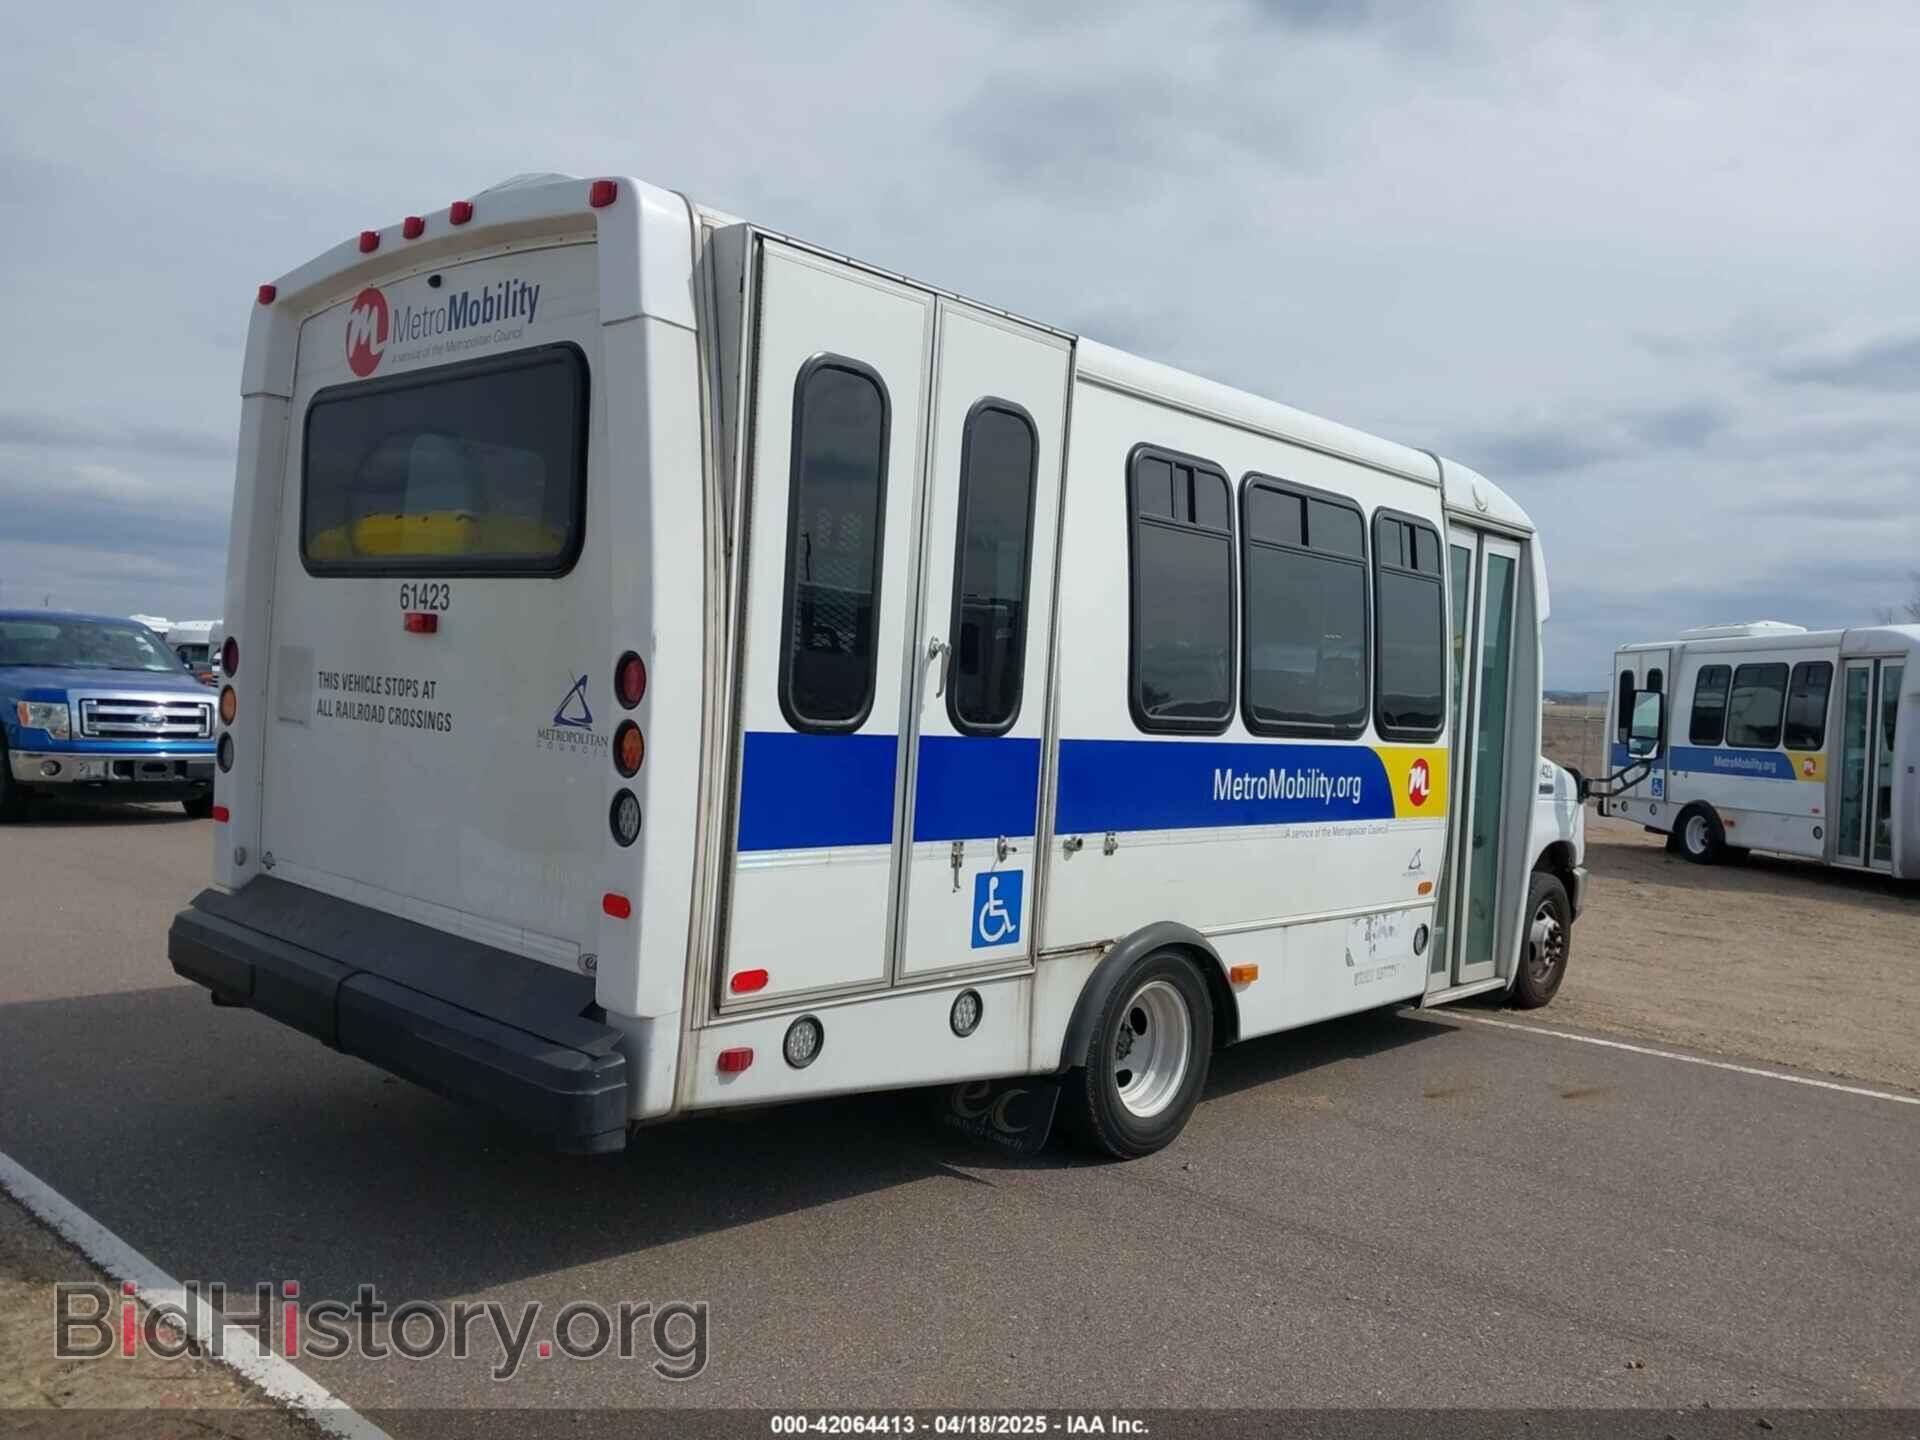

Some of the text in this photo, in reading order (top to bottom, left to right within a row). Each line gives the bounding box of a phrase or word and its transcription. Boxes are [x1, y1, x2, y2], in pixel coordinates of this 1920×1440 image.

[392, 278, 541, 344] MetroMobility
[400, 583, 450, 611] 61423
[318, 671, 437, 700] THIS VEHICLE STOPS AT
[317, 698, 453, 732] ALL RAILROAD CROSSINGS
[537, 727, 609, 748] METROPOLITAN
[1213, 768, 1362, 805] MetroMobility.org
